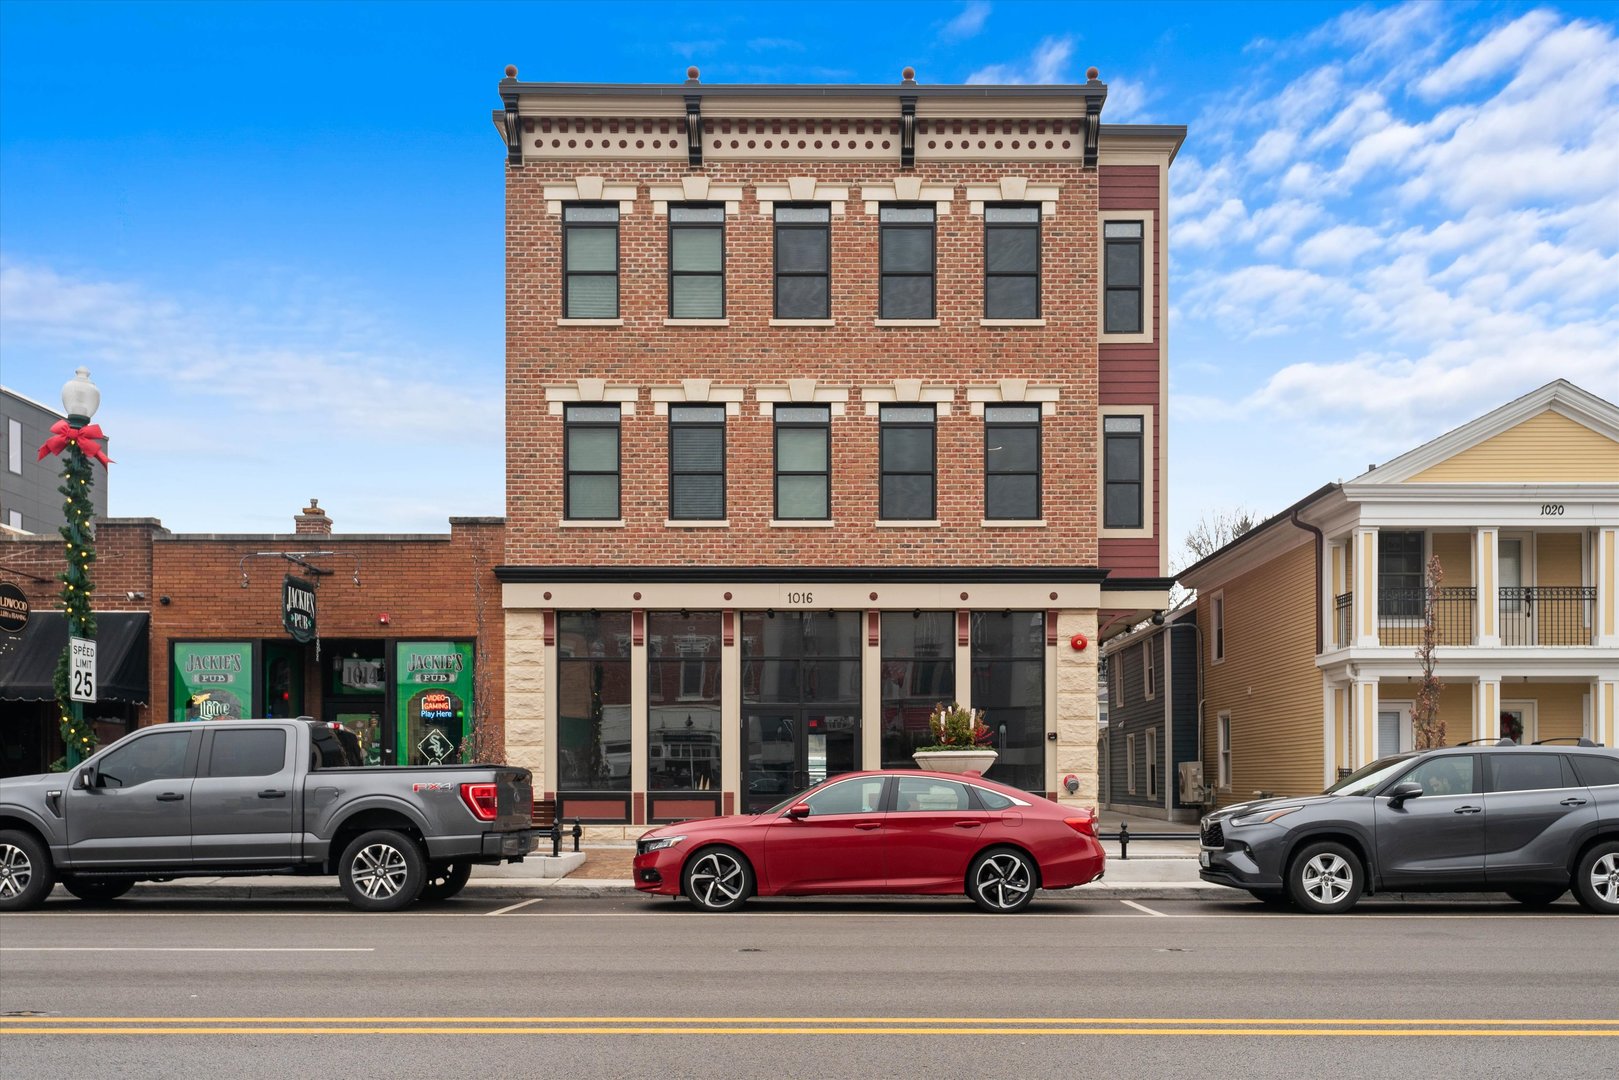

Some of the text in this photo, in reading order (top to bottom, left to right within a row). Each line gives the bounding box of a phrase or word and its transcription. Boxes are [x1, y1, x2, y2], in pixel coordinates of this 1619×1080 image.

[1540, 504, 1565, 516] 1020
[286, 585, 315, 619] JACKIE'S
[787, 592, 813, 604] 1016
[294, 612, 308, 630] PUB
[73, 645, 95, 658] SPEED
[75, 658, 92, 669] LIMIT
[186, 653, 242, 672] JACKIE'S
[407, 653, 463, 672] JACKIE'S
[202, 674, 226, 682] PUB
[346, 665, 377, 685] 1014
[423, 674, 448, 682] PUB
[74, 670, 93, 697] 25
[426, 694, 446, 702] VIDEO
[424, 702, 449, 710] GAMING
[420, 710, 453, 719] Play Here
[412, 783, 454, 793] FX4
